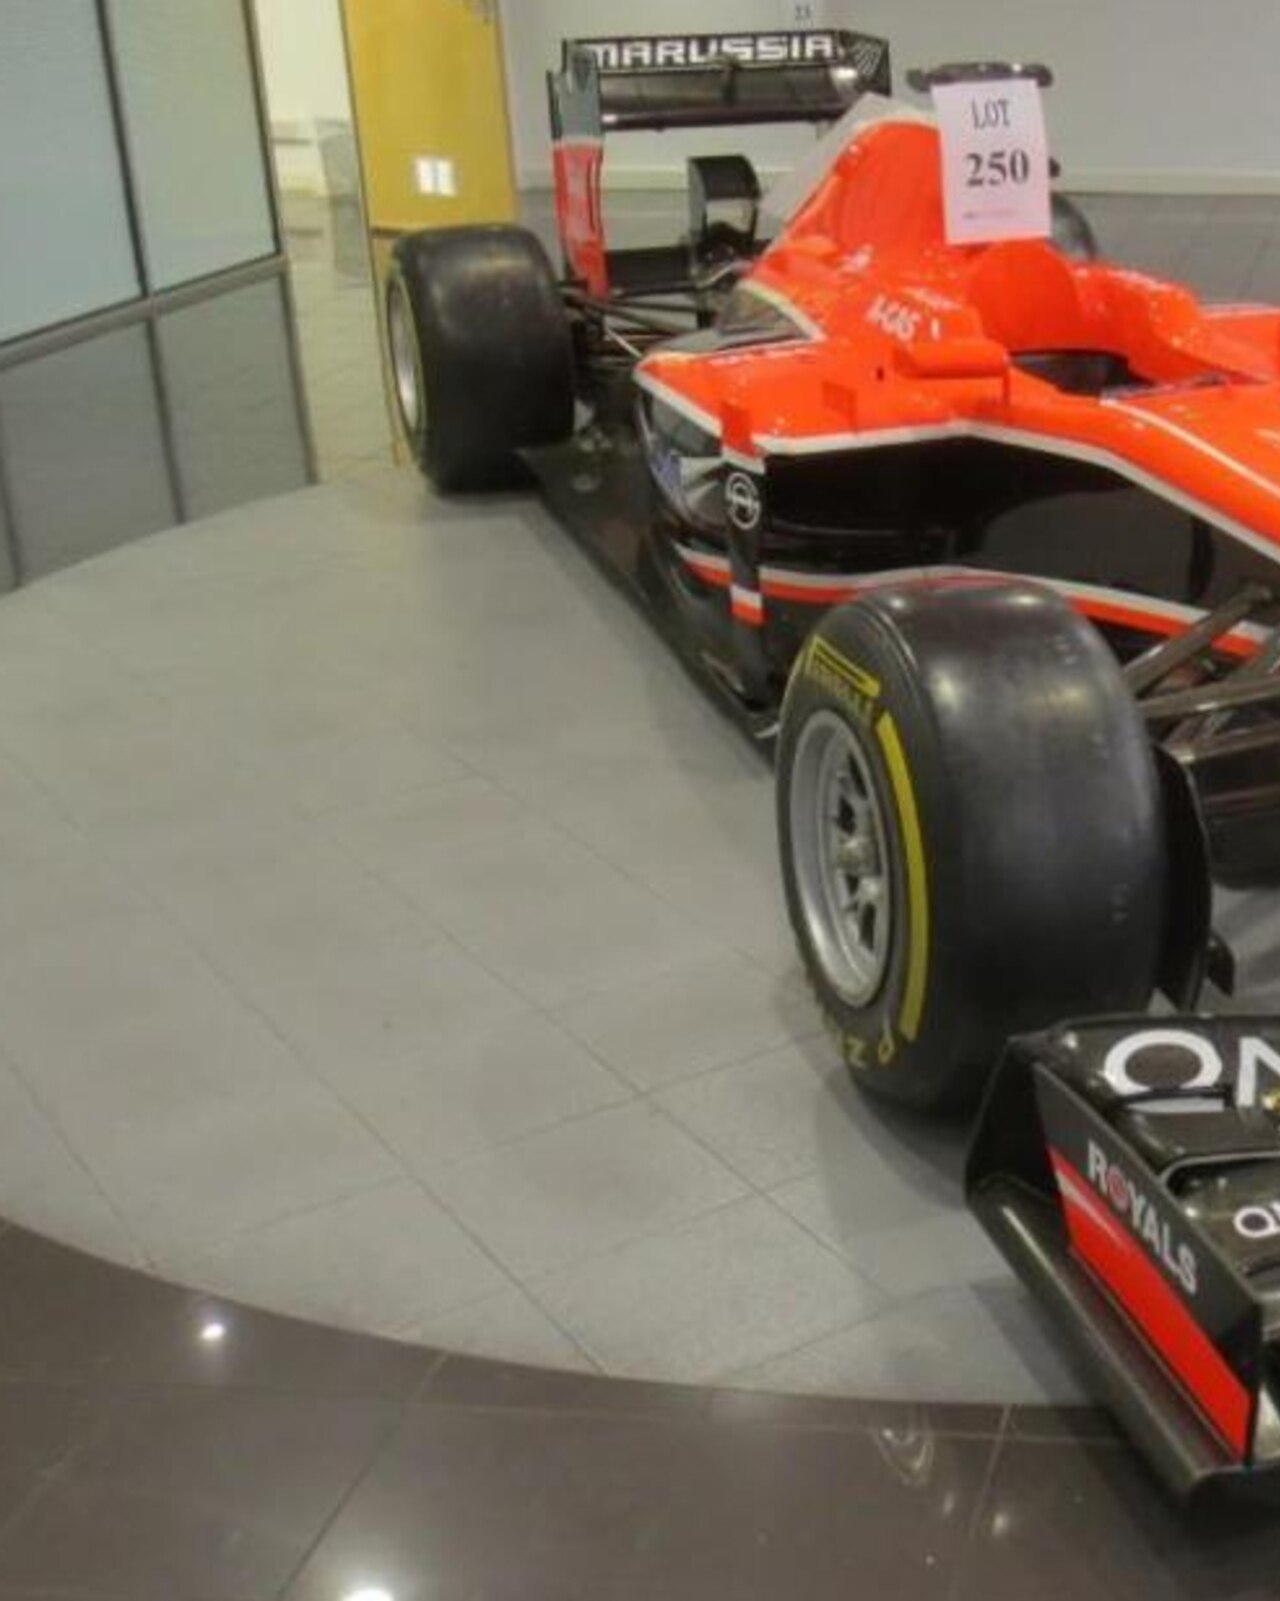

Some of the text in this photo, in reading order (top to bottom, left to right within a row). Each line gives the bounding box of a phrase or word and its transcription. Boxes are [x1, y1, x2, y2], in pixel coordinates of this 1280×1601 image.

[586, 32, 834, 68] MARUSSIA
[971, 97, 1010, 130] LOT
[966, 149, 1030, 187] 250
[1088, 1139, 1198, 1296] ROYALS
